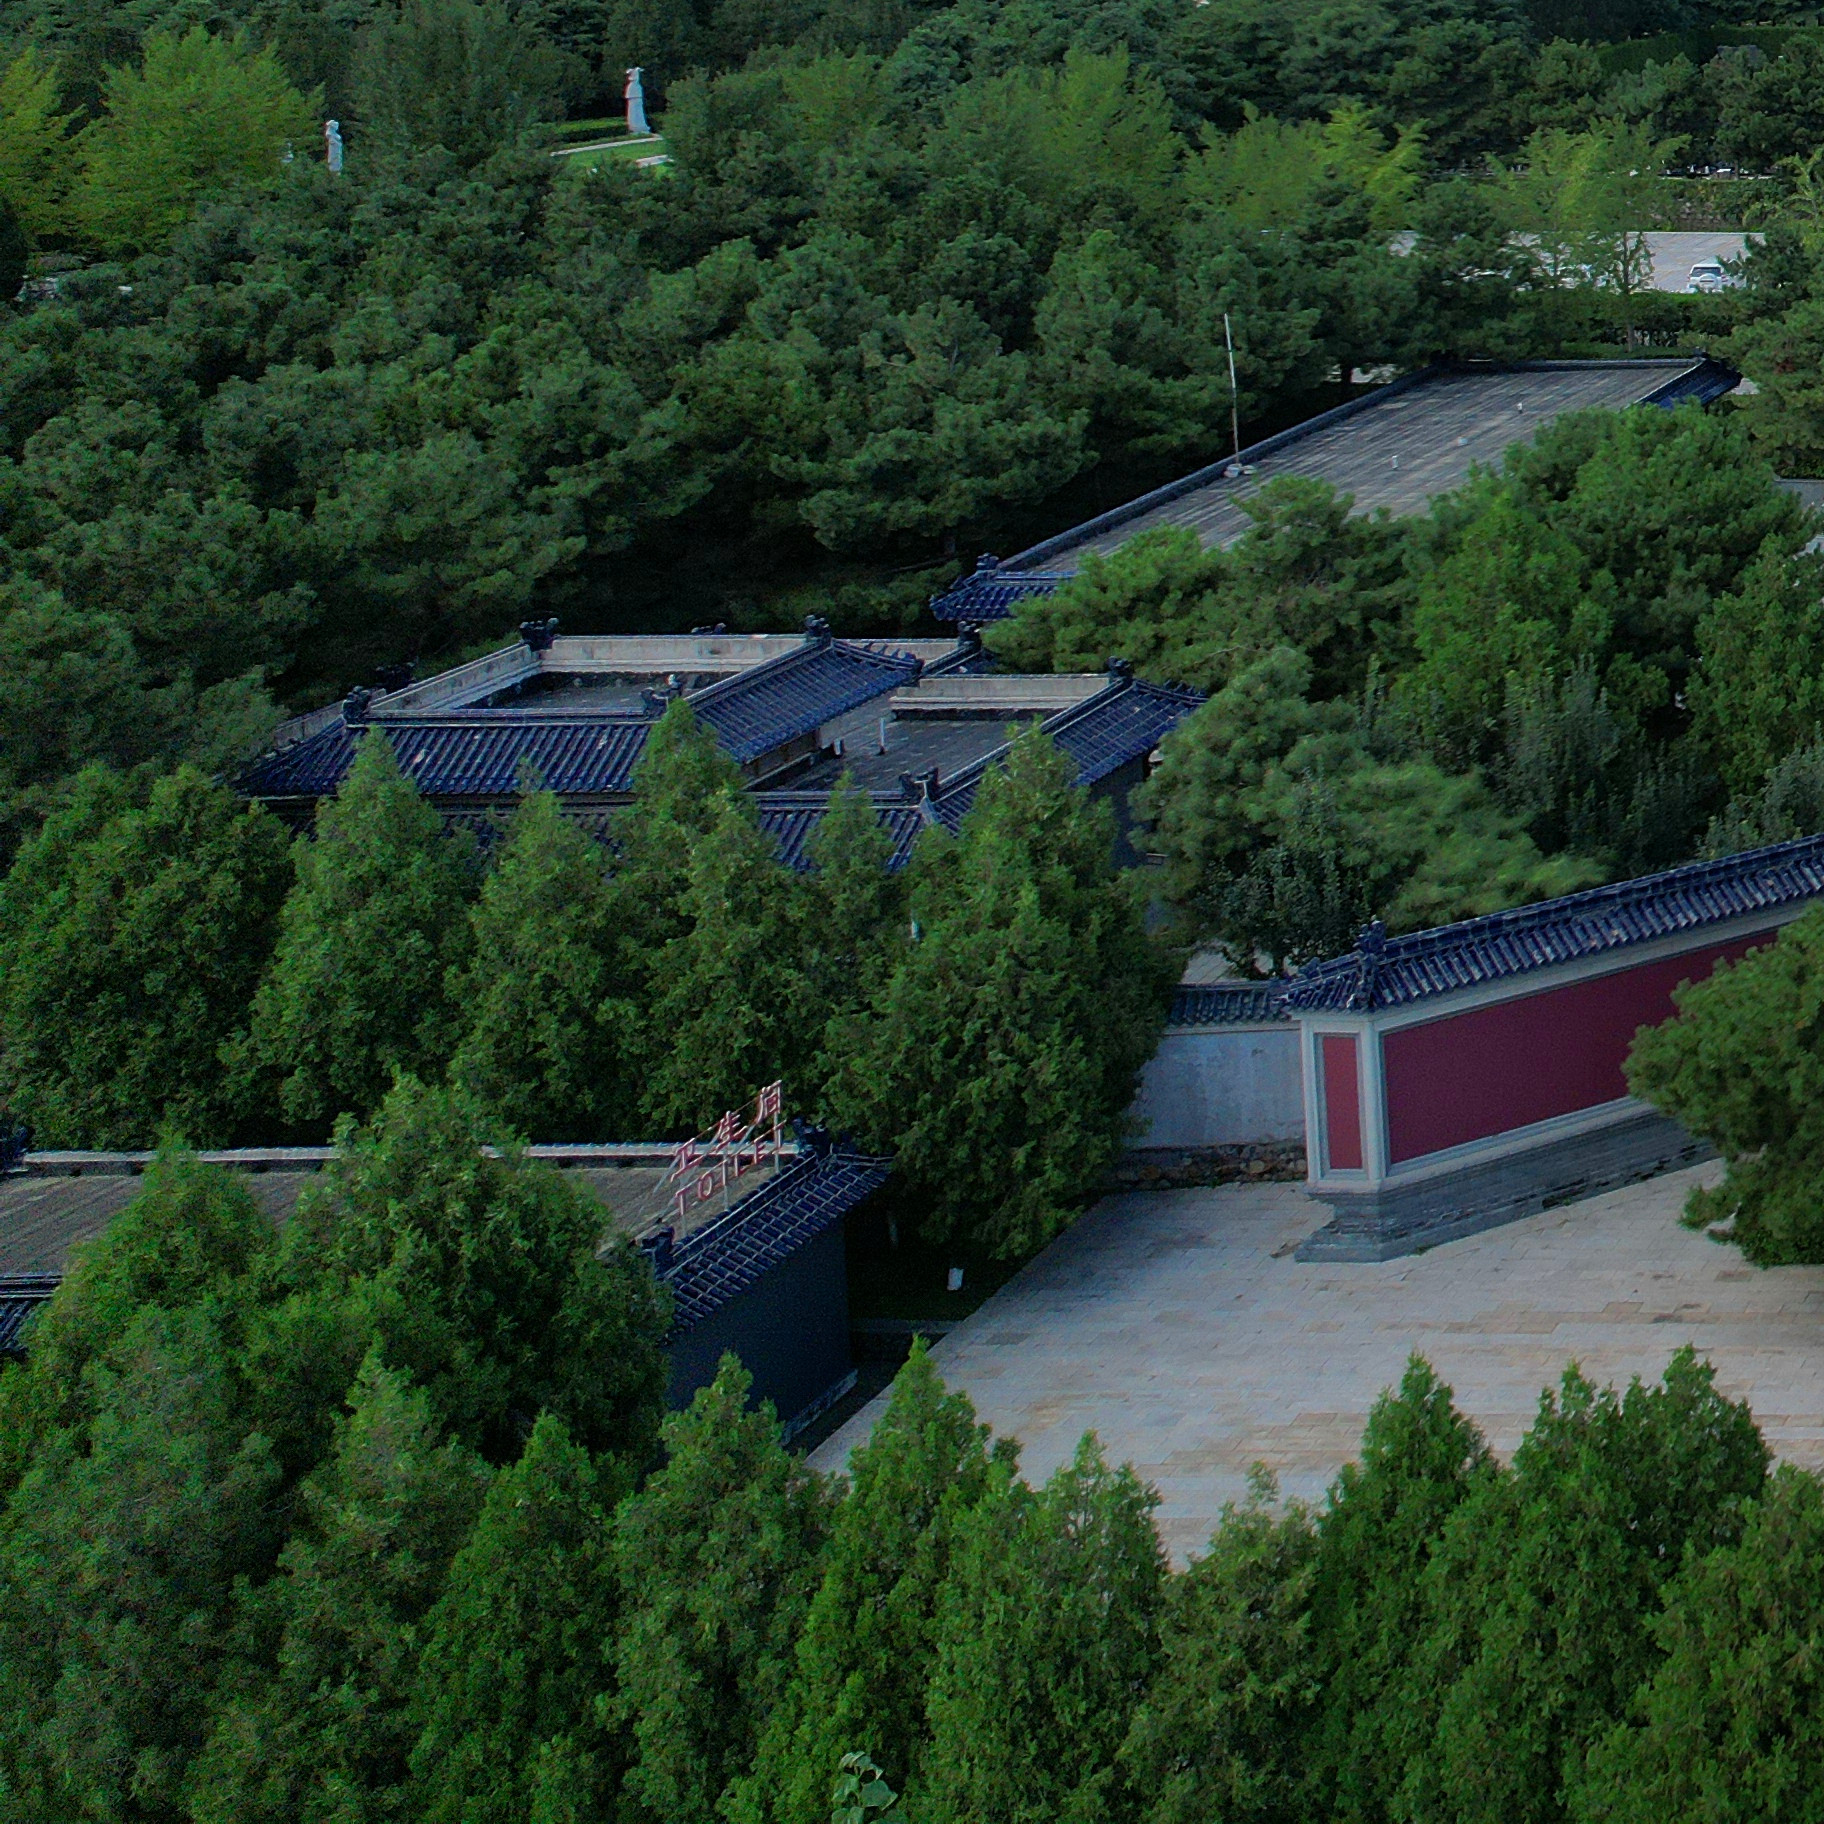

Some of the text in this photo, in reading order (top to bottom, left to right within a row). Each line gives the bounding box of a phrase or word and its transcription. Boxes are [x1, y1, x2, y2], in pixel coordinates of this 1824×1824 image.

[670, 1080, 783, 1183] 卫生间
[674, 1119, 788, 1215] TOILET
